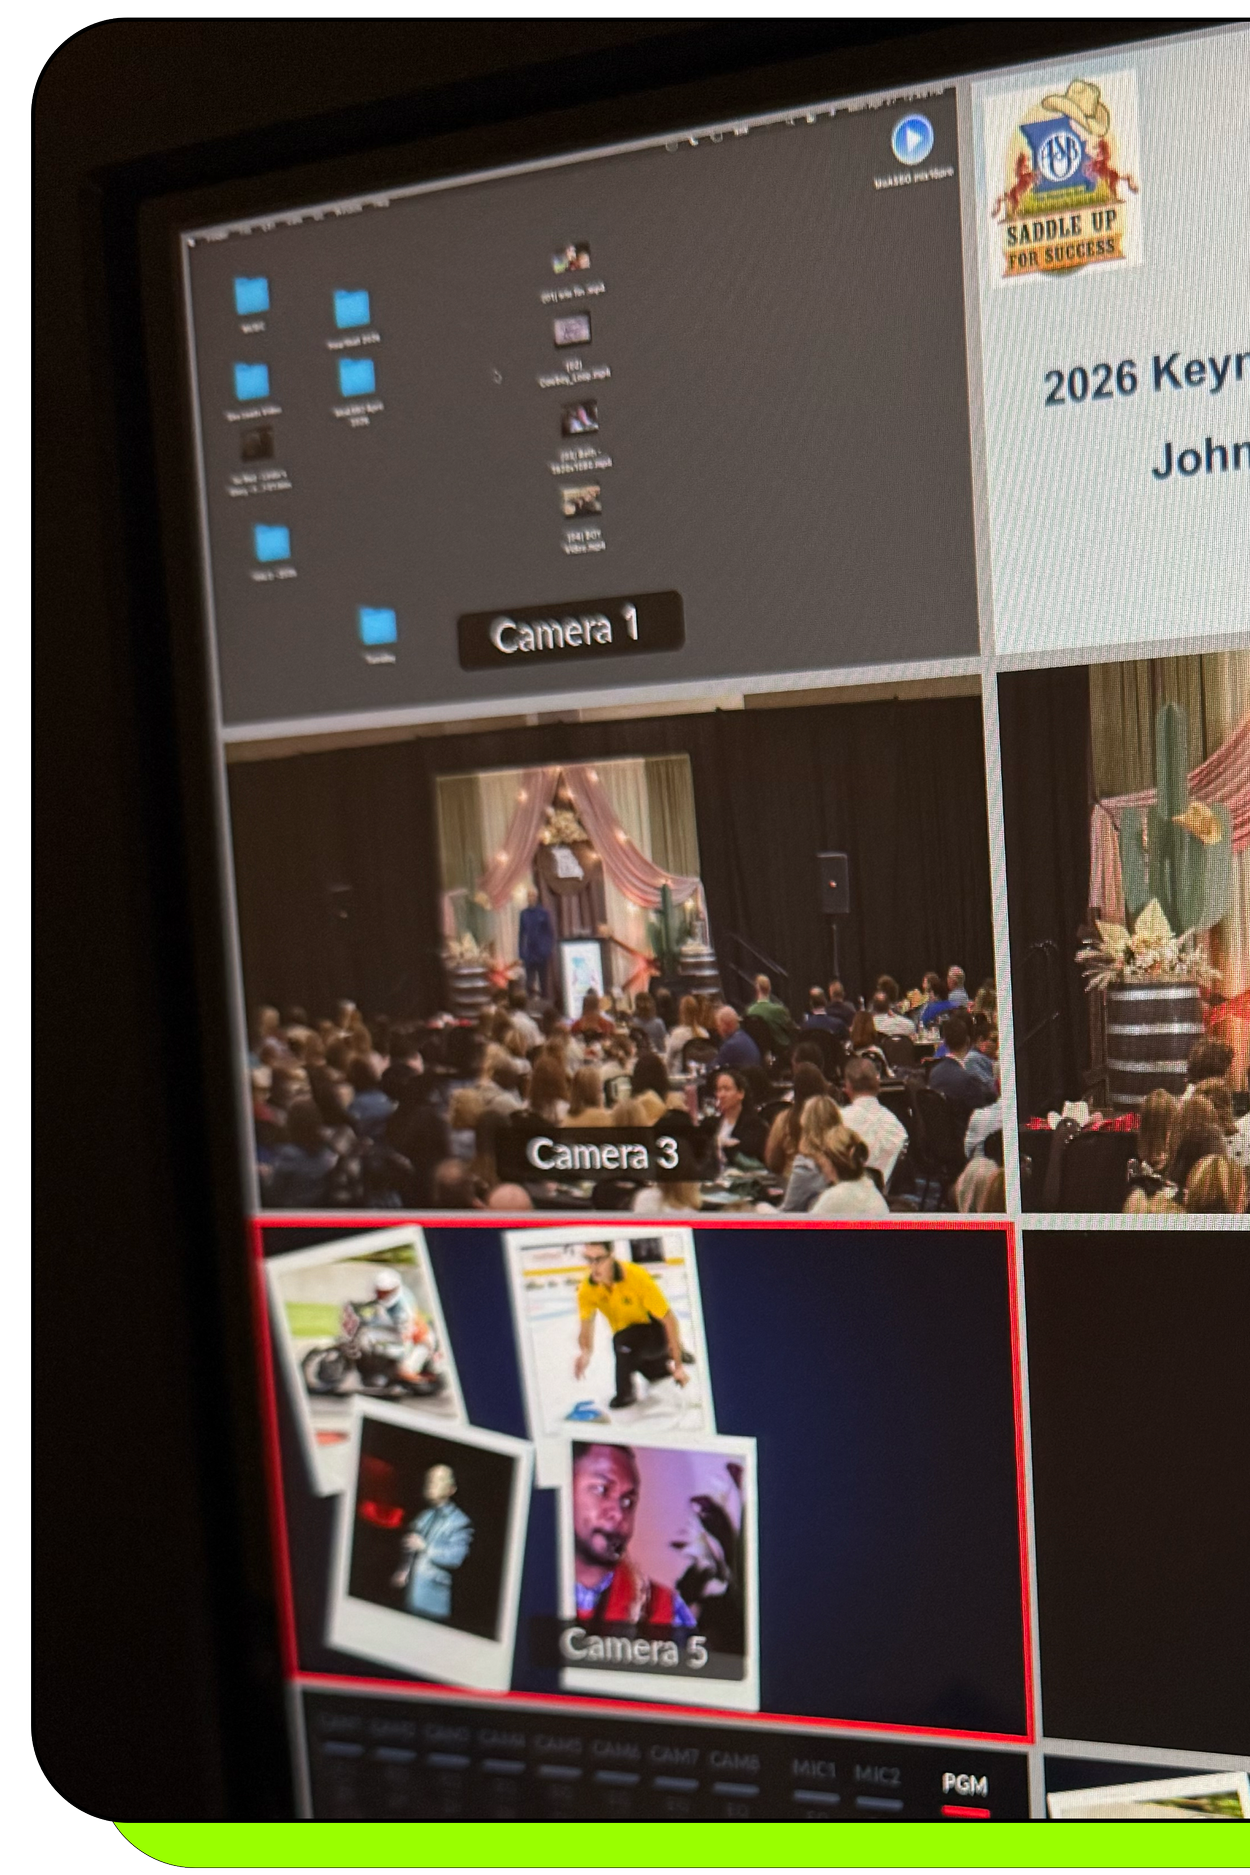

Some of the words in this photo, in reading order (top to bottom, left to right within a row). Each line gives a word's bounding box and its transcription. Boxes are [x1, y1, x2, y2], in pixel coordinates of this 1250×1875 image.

[1007, 214, 1082, 247] SADDLE
[1092, 209, 1117, 232] UP
[1009, 251, 1040, 270] FOR
[1044, 238, 1115, 263] SUCCESS
[1044, 359, 1138, 406] 2026
[490, 614, 614, 654] Camera
[620, 601, 640, 642] 1
[526, 1136, 649, 1170] Camera
[656, 1136, 679, 1170] 3
[561, 1626, 679, 1666] Camera
[686, 1635, 709, 1669] 5
[650, 1744, 698, 1766] CAM7
[793, 1758, 838, 1779] MIC1
[855, 1764, 902, 1787] MIC2
[942, 1771, 990, 1797] PGM
